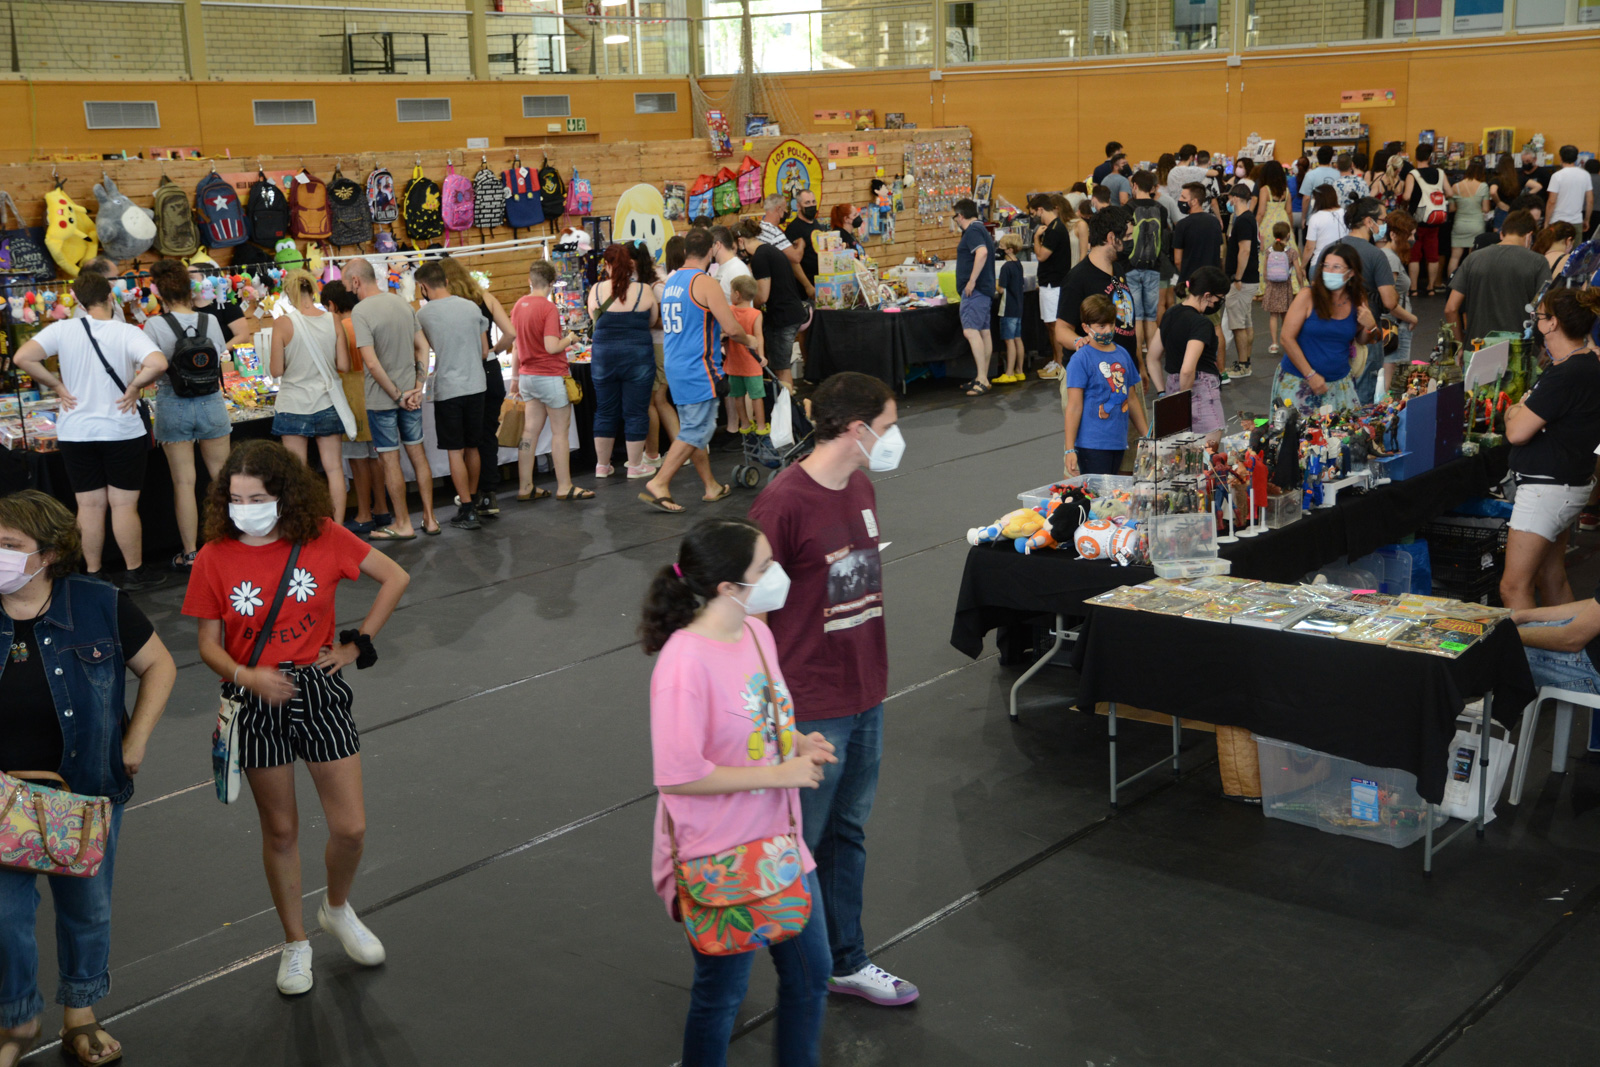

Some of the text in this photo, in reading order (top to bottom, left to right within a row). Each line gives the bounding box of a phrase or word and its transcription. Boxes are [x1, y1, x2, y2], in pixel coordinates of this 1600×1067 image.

[772, 146, 813, 166] LOS POLLOS
[662, 302, 683, 334] 35
[268, 612, 317, 644] FELIZ
